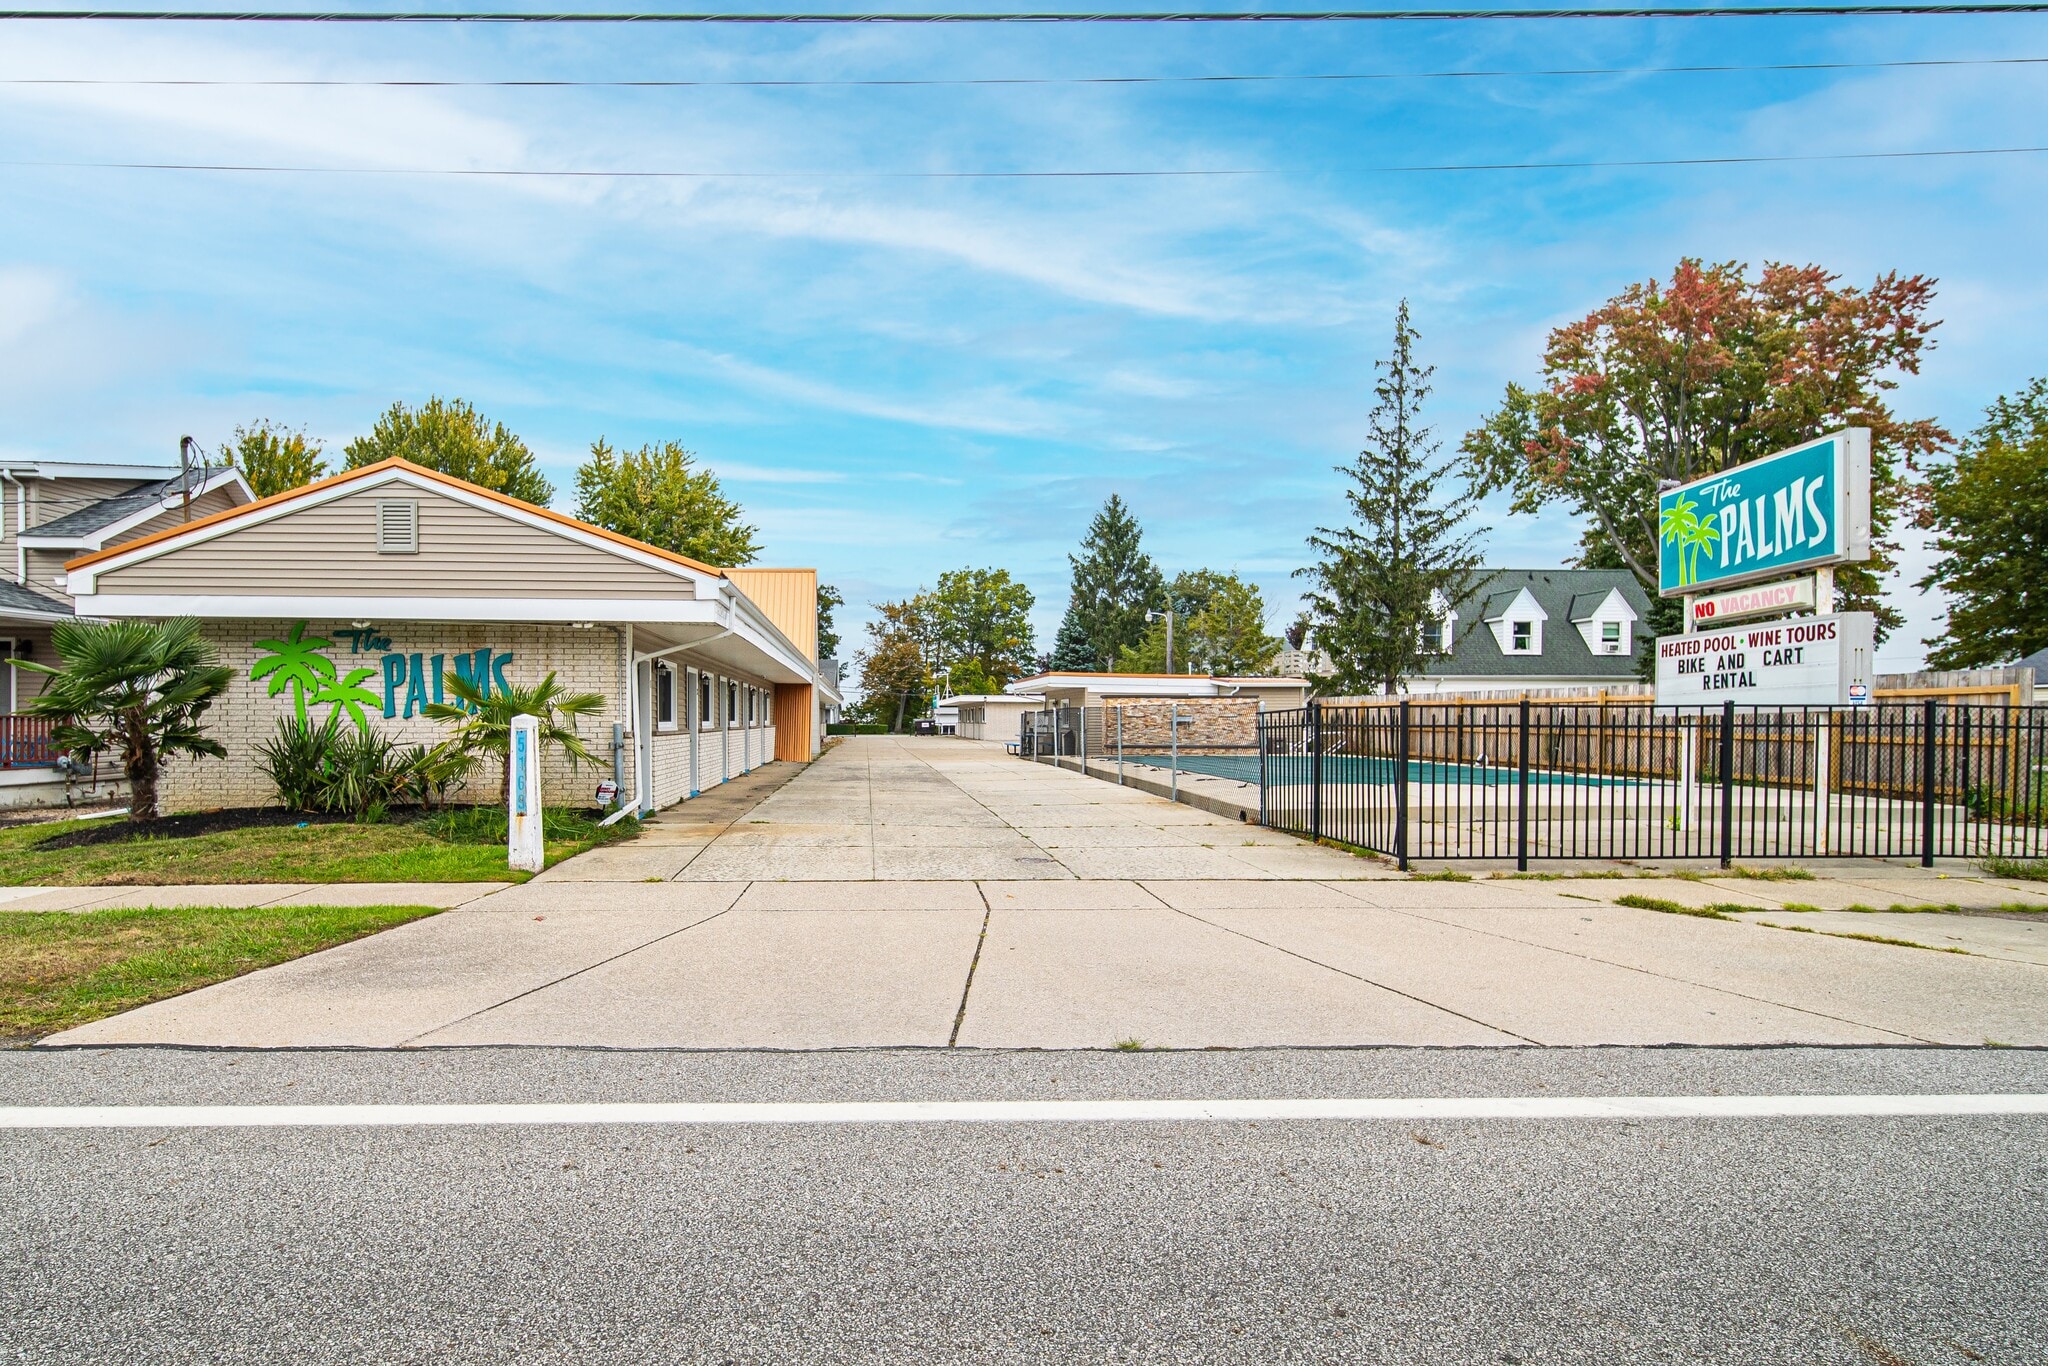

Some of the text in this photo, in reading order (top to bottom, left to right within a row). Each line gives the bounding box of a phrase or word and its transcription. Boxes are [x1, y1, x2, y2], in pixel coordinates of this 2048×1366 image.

[1699, 479, 1741, 506] The
[1719, 475, 1827, 568] PALMS
[1695, 586, 1797, 618] NO VACANCY
[333, 628, 392, 653] The
[1661, 622, 1836, 658] HEATED POOL WINE TOURS
[1678, 647, 1803, 675] BIKE AND CART
[1703, 671, 1757, 690] RENTAL
